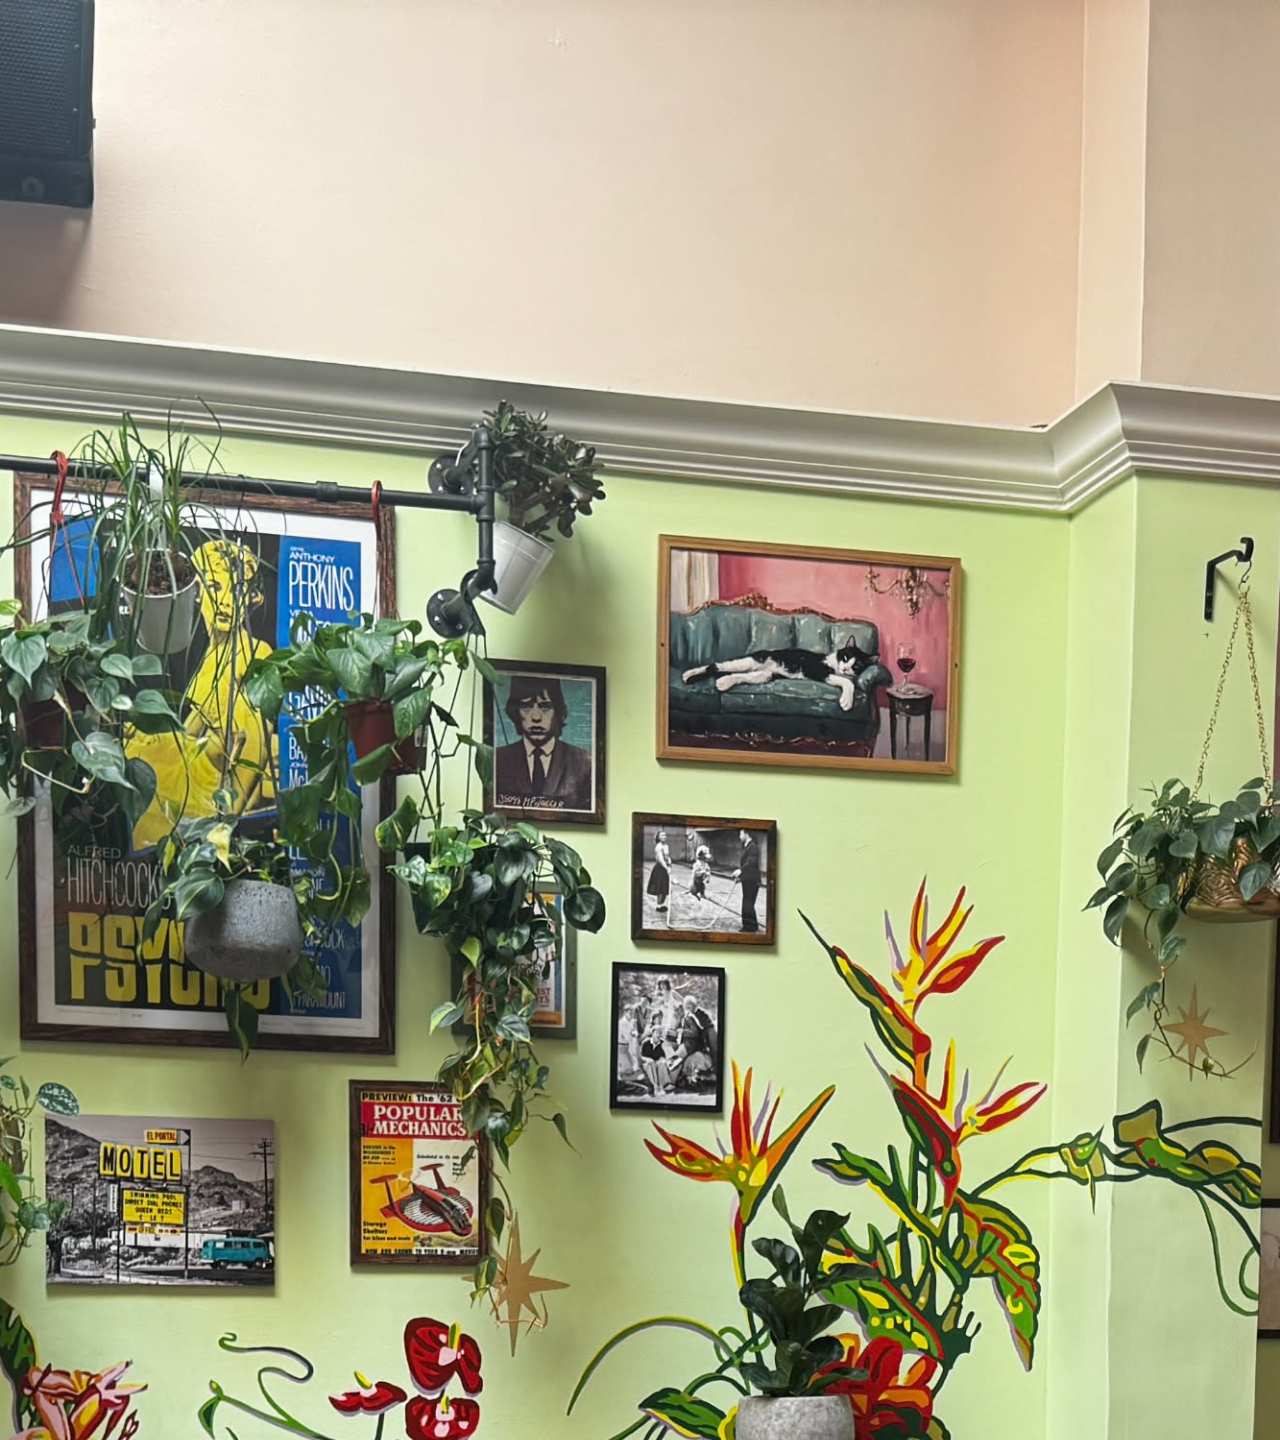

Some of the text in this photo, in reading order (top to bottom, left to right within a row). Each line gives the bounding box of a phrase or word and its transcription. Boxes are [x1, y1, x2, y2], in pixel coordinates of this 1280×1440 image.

[289, 551, 335, 563] ANTHONY
[288, 560, 355, 612] PERKINS
[69, 845, 121, 859] ALFRED
[68, 911, 271, 1011] PSYC
[374, 1104, 464, 1121] POPULAR
[373, 1120, 467, 1137] MECHANICS
[103, 1145, 181, 1177] MOTEL
